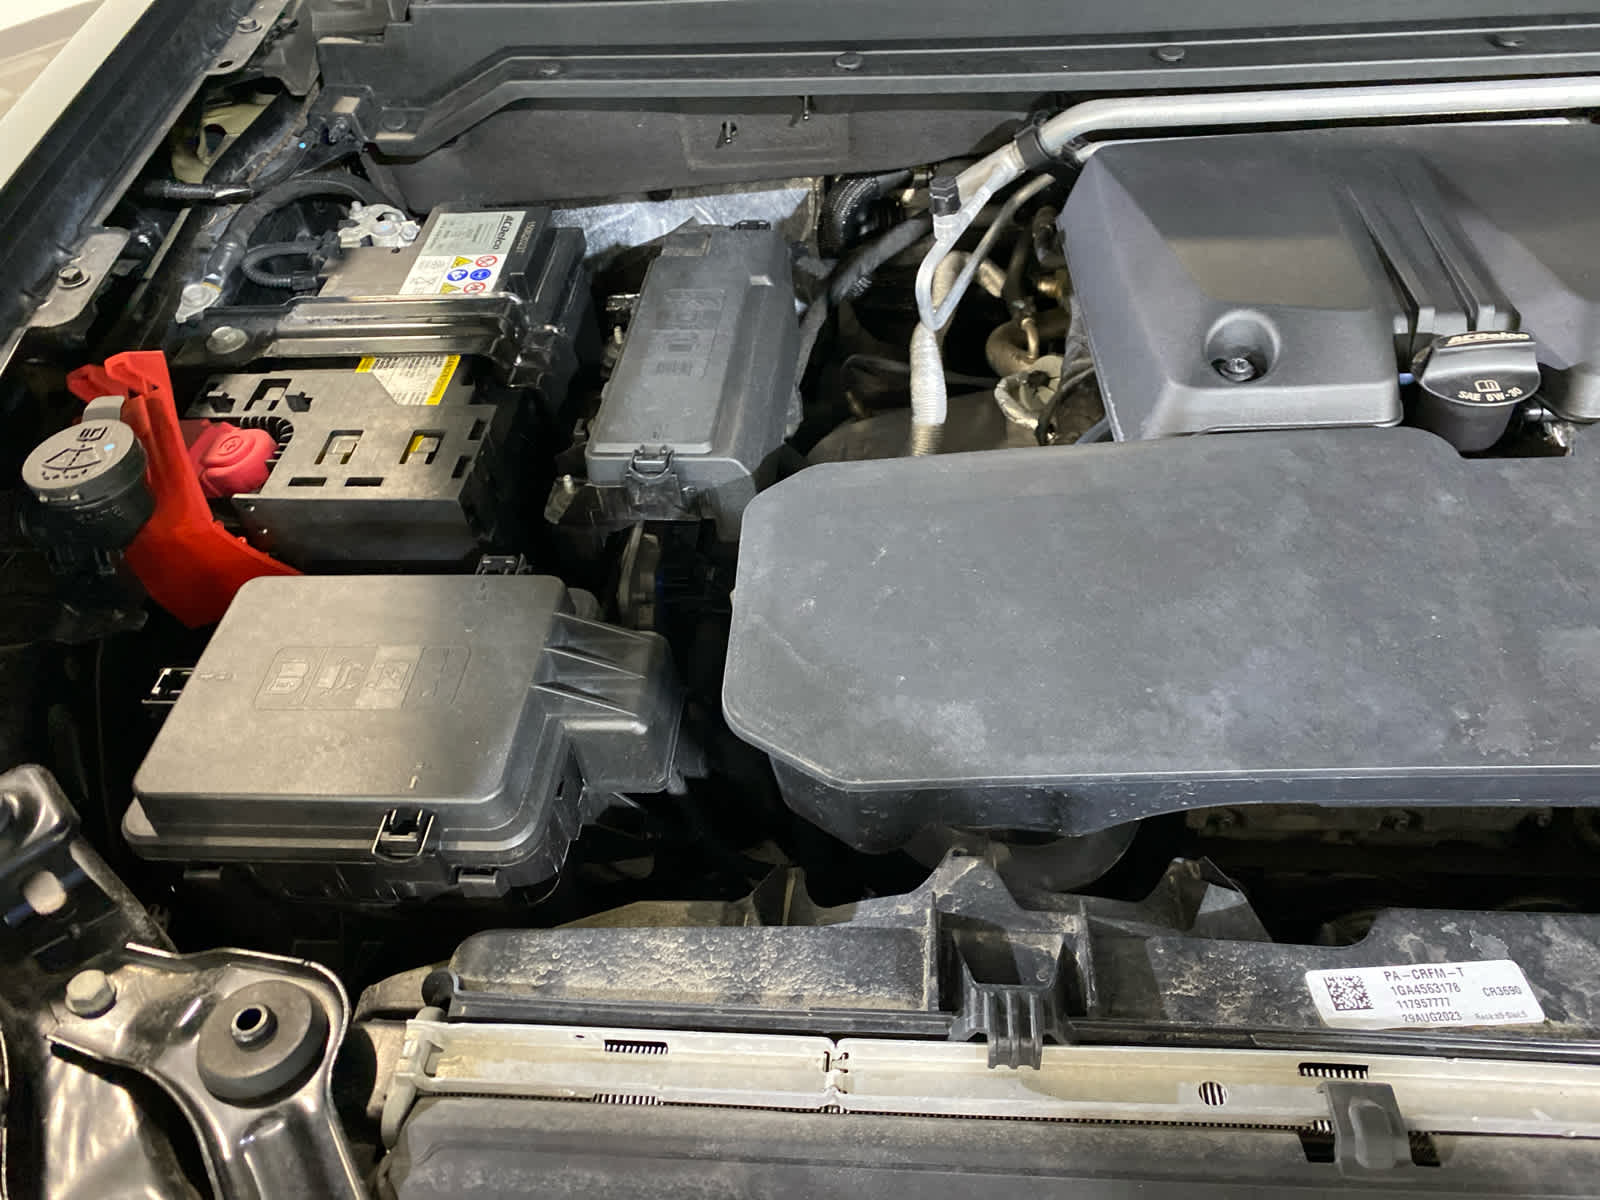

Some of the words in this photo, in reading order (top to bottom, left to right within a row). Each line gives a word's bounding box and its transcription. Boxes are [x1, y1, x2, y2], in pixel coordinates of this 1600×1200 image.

[492, 215, 515, 250] ACDelco
[1458, 390, 1481, 401] SAE
[1383, 967, 1465, 982] PA-CRFM-T
[1390, 982, 1462, 996] 1GA4563178
[1396, 997, 1451, 1009] 117957777
